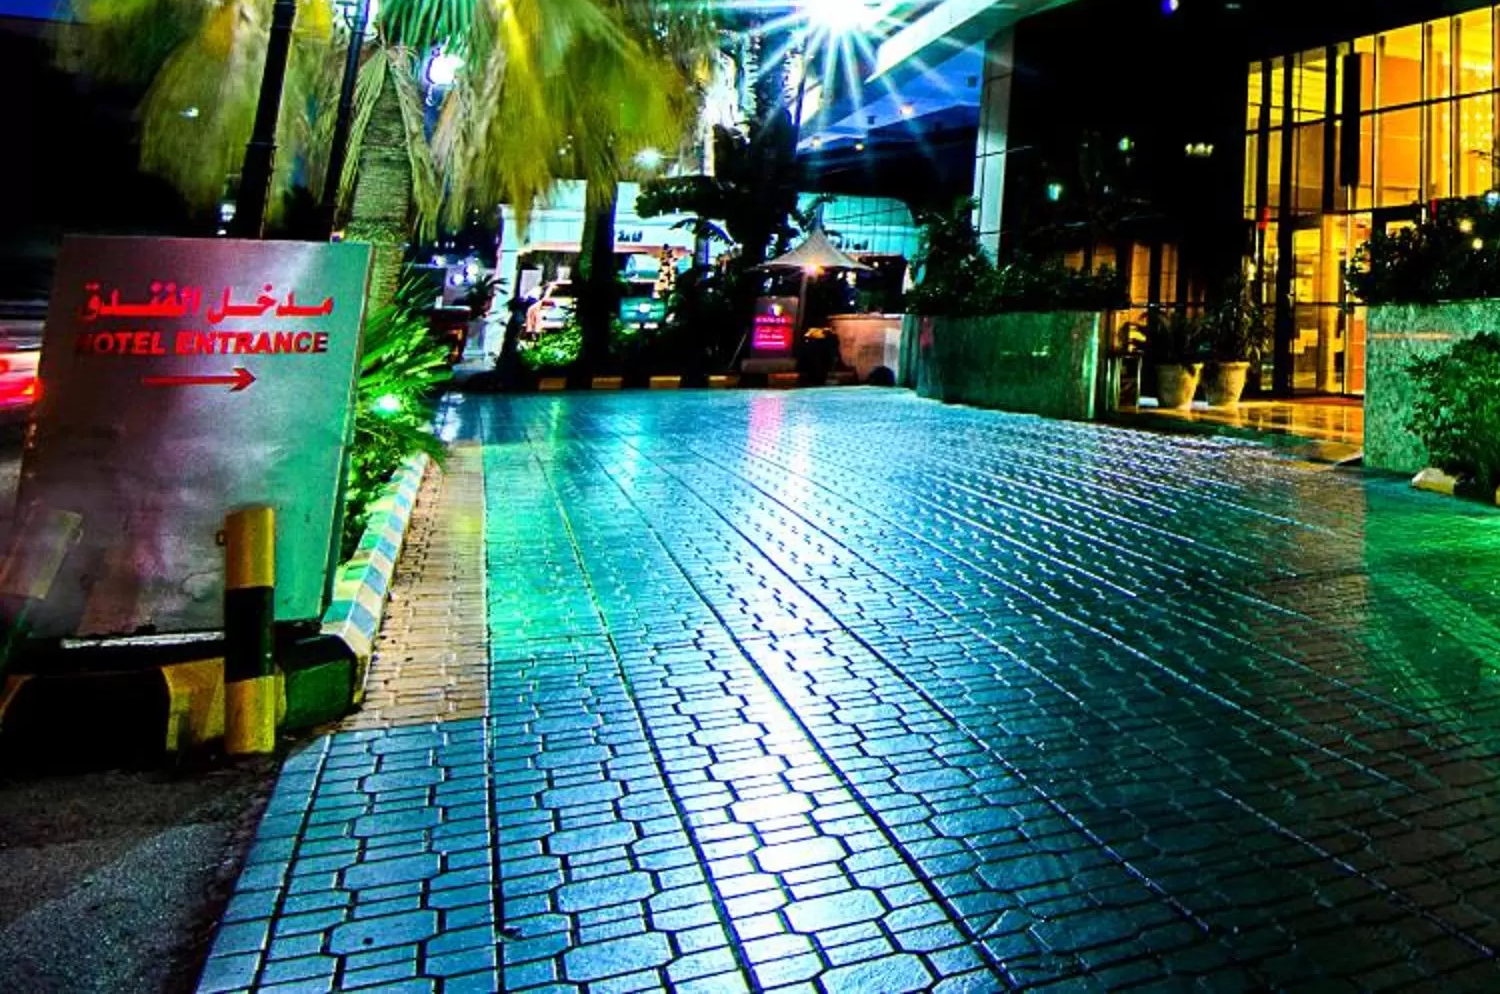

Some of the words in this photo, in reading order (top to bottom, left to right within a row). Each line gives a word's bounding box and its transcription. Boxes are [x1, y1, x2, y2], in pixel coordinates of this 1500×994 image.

[81, 282, 203, 322] الفندق
[208, 284, 334, 324] مدخل
[76, 330, 166, 355] HOTEL
[175, 330, 329, 354] ENTRANCE
